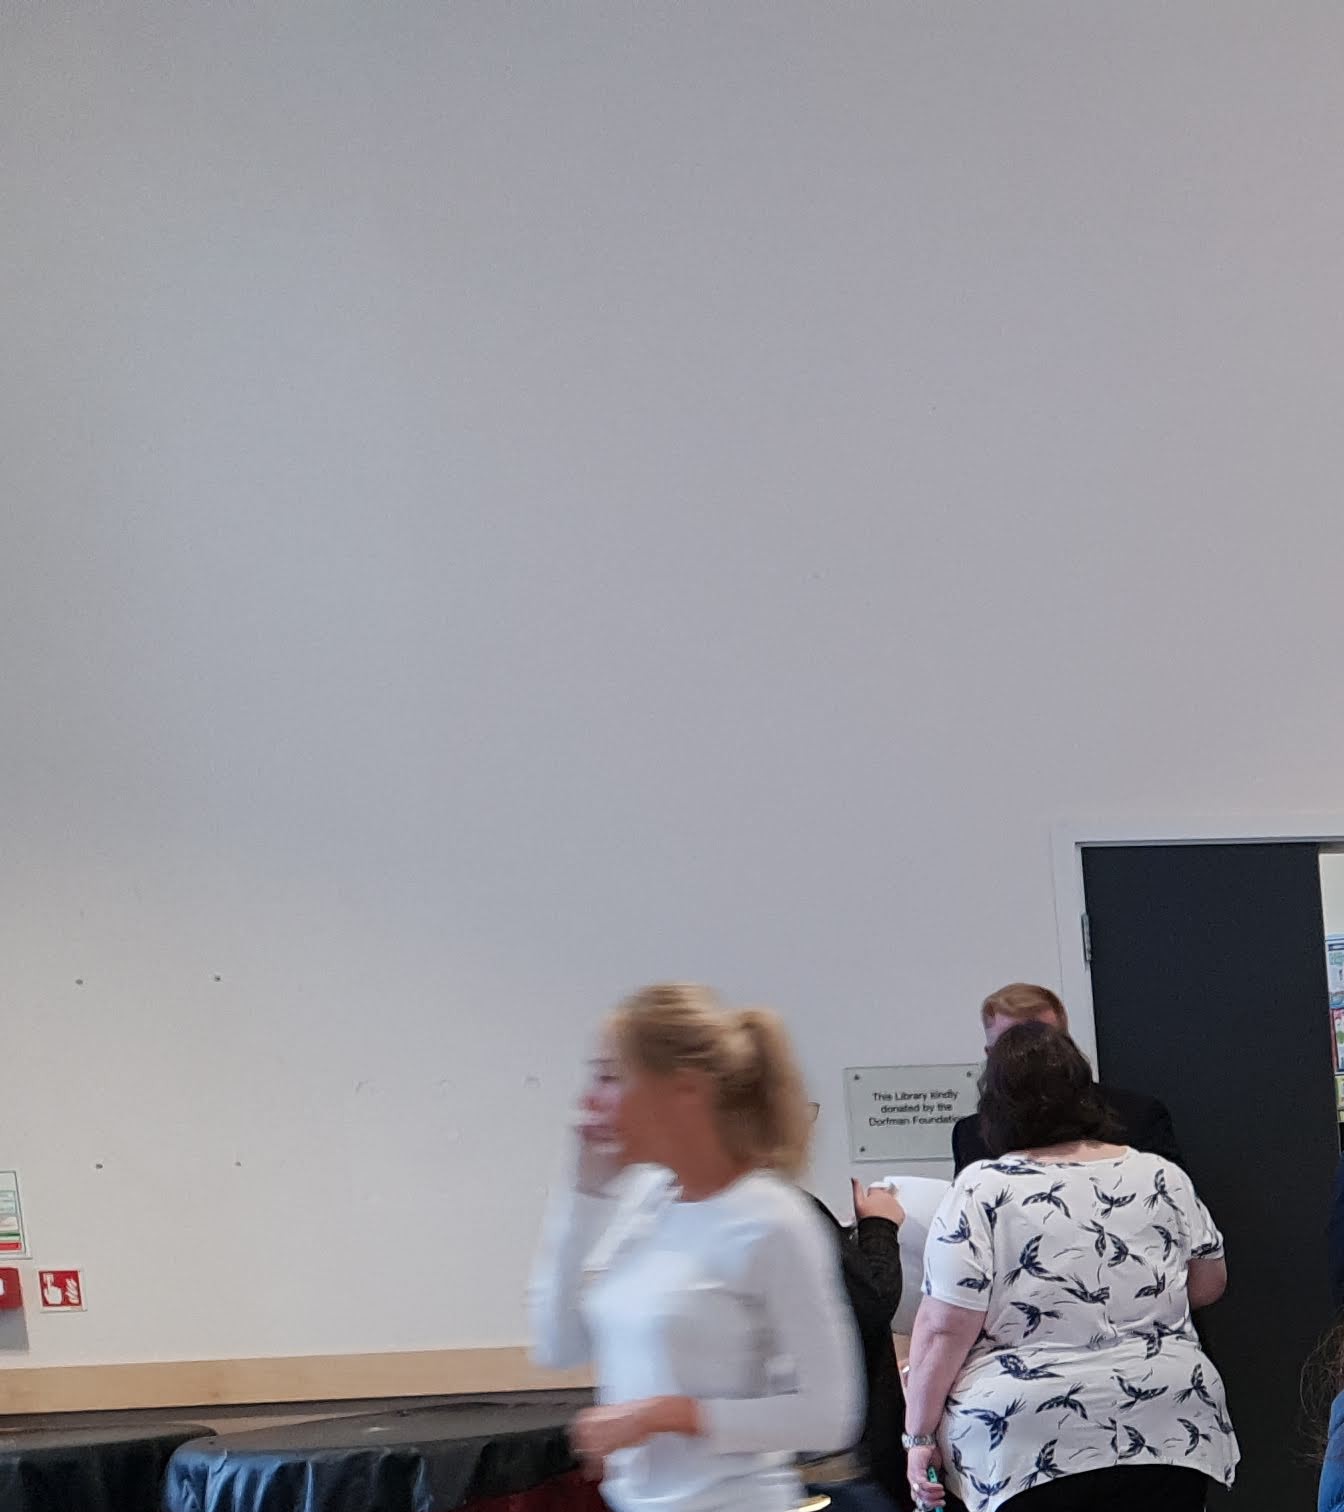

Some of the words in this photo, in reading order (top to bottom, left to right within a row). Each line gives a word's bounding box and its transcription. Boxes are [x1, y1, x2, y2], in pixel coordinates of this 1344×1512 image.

[873, 1092, 893, 1101] This
[894, 1091, 928, 1102] Library
[881, 1104, 920, 1113] donated
[922, 1105, 935, 1115] by
[937, 1103, 952, 1112] the
